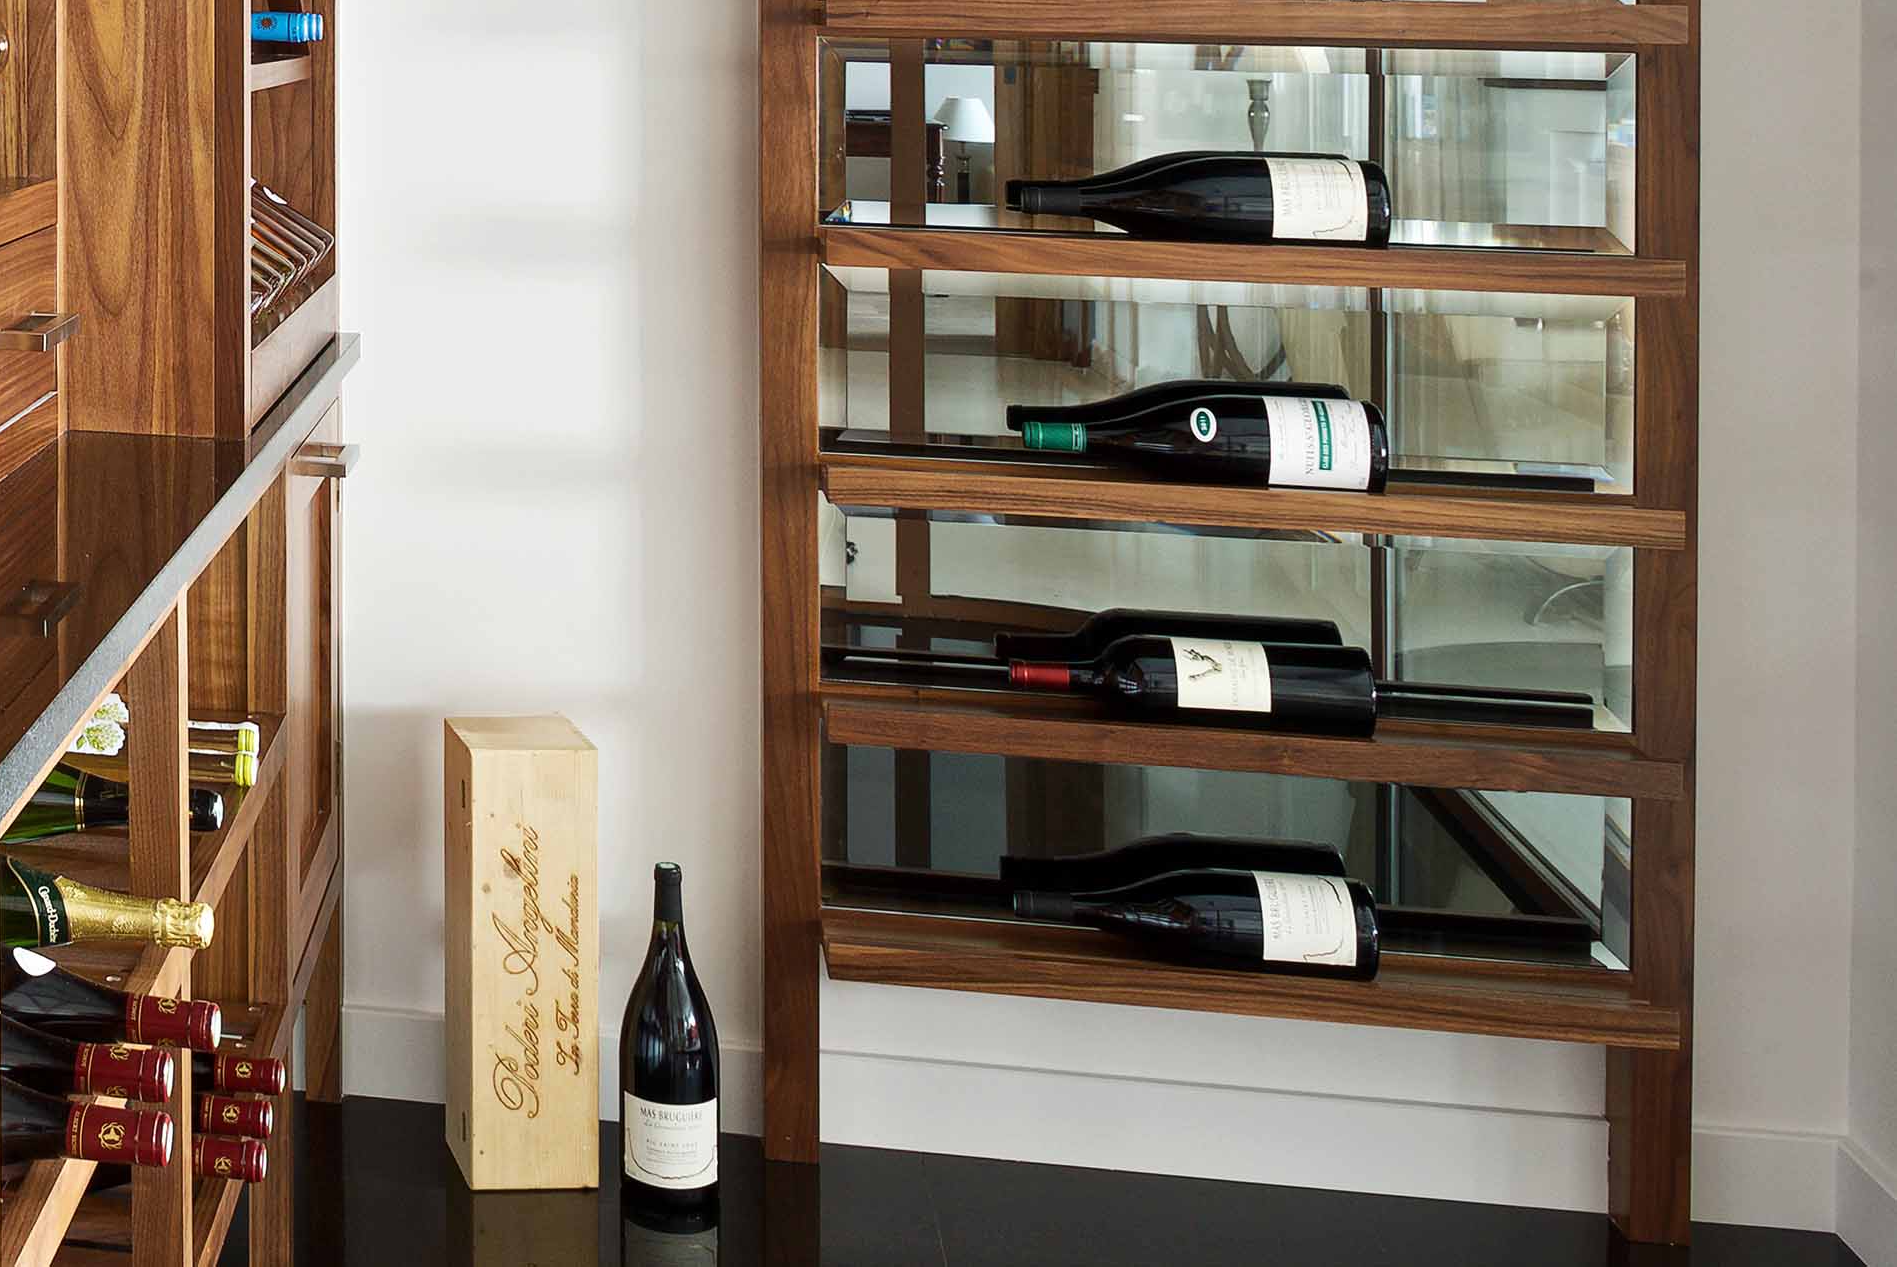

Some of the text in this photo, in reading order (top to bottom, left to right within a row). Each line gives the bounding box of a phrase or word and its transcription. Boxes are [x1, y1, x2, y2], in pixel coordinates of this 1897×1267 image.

[492, 823, 553, 1119] Poderi Angelini
[561, 968, 580, 990] di
[640, 1106, 656, 1119] MAS
